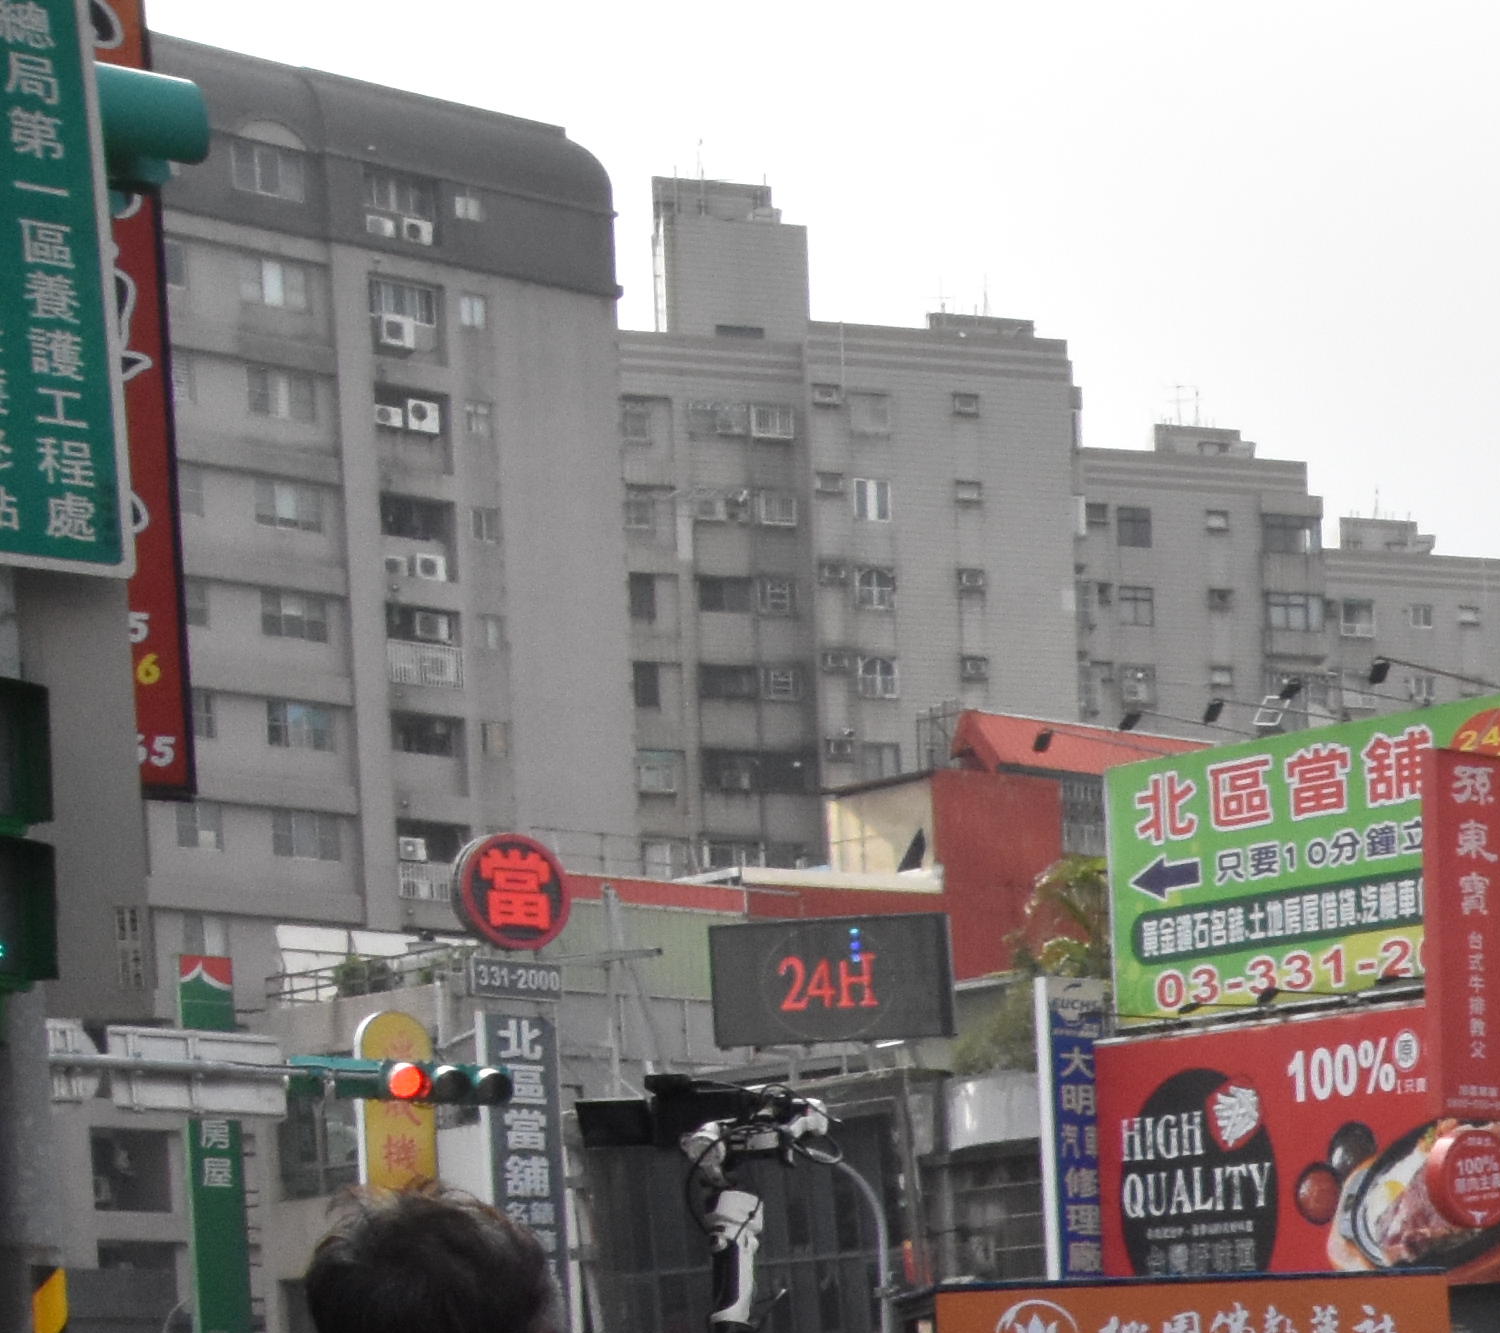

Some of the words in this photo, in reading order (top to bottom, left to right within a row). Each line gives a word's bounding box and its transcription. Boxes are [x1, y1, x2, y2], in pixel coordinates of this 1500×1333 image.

[1134, 724, 1432, 845] 北區當舖
[480, 847, 552, 931] 當
[478, 963, 561, 992] 331-2000
[779, 952, 880, 1011] 24H
[1287, 1036, 1397, 1103] 100%
[496, 1017, 550, 1198] 北區當舖
[1121, 1110, 1204, 1162] HIGH
[201, 1117, 232, 1188] 房屋
[1121, 1162, 1272, 1219] QUALITY
